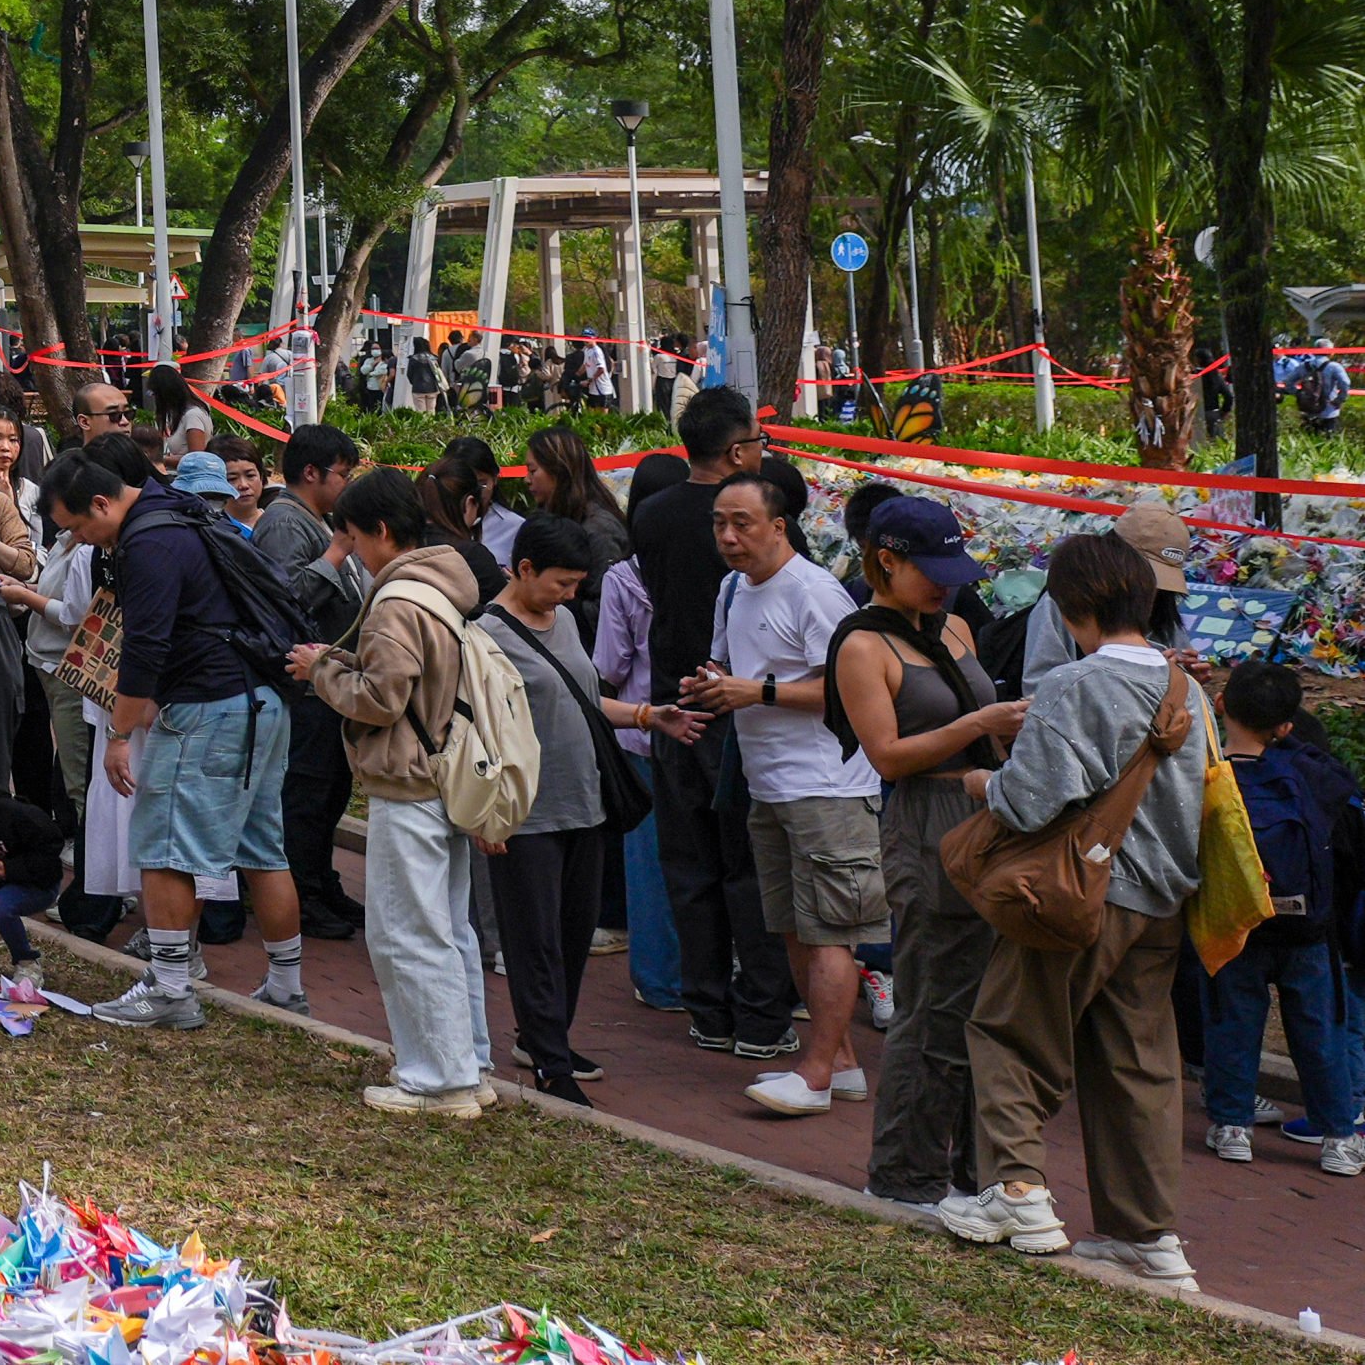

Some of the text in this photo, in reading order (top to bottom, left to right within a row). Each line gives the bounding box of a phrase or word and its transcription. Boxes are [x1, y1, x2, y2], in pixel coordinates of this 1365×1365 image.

[92, 598, 123, 629] MUJ
[102, 647, 122, 671] GO
[58, 662, 118, 713] HOLIDAYS
